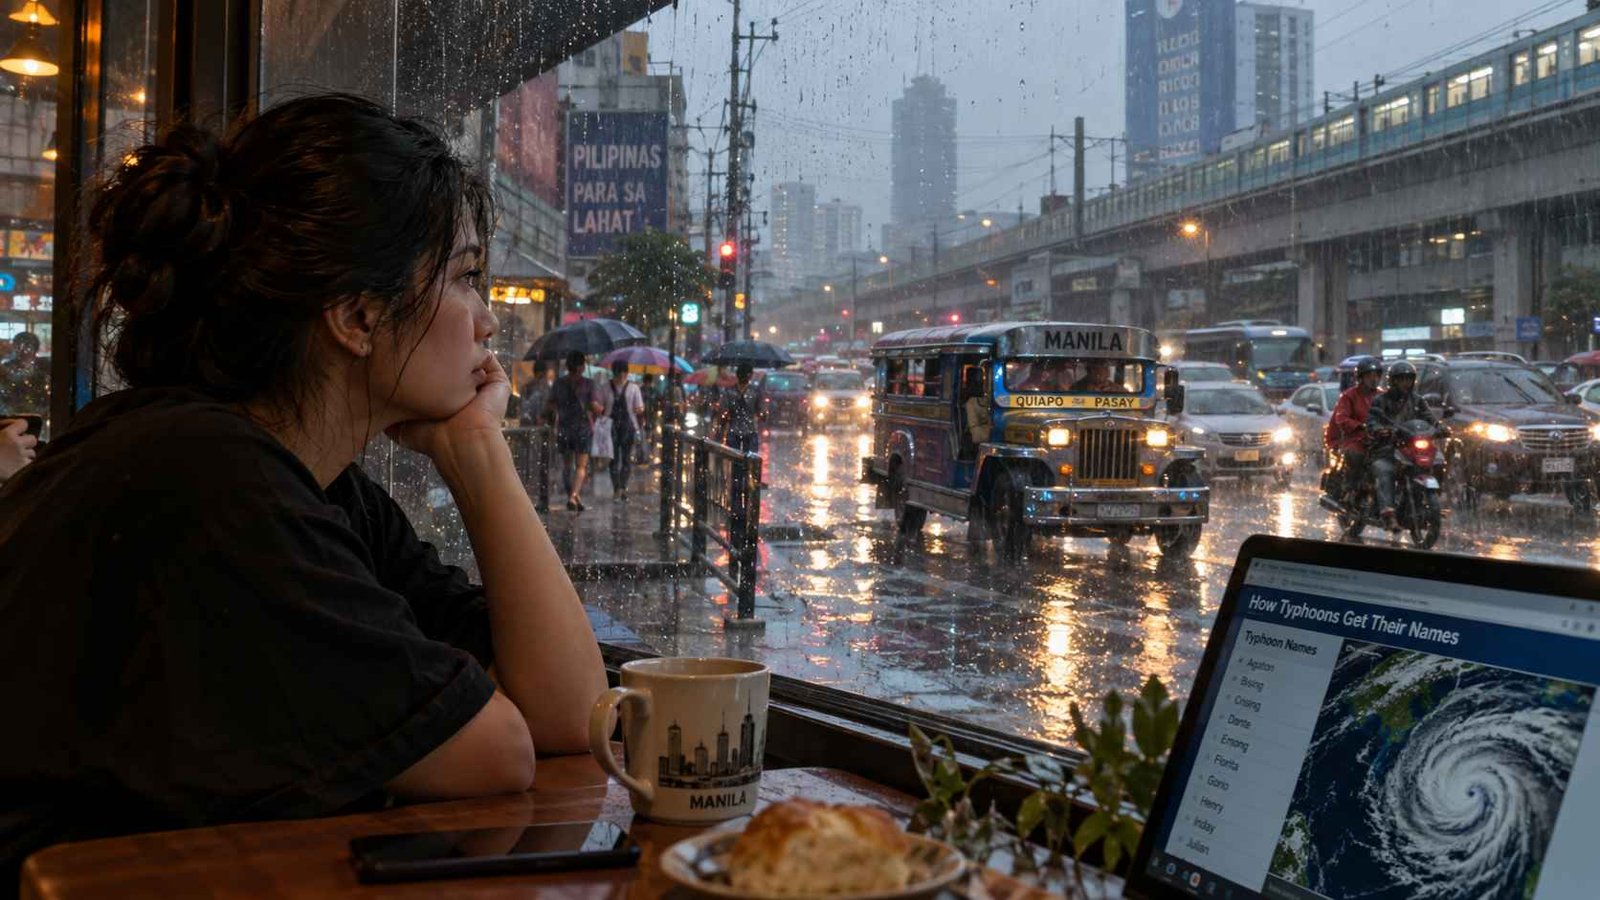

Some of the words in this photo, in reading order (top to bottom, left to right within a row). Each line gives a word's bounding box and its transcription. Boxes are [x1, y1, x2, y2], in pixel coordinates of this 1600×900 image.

[574, 145, 661, 168] PILIPINAS
[574, 182, 618, 203] PARA
[624, 181, 646, 203] SA
[574, 210, 634, 232] LAHAT
[1044, 331, 1123, 351] MANILA
[1016, 396, 1064, 407] QUIAPO
[1095, 397, 1135, 408] PASAY
[1248, 594, 1278, 612] How
[1279, 599, 1340, 625] Typhoons
[1342, 610, 1368, 629] Get
[1371, 614, 1408, 636] Their
[1408, 620, 1460, 645] Names
[1244, 630, 1283, 650] Typhoon
[1285, 639, 1318, 656] Names
[1241, 677, 1263, 692] Bising
[1228, 715, 1251, 729] Dante
[1221, 735, 1248, 752] Emong
[691, 792, 745, 808] MANILA
[1201, 797, 1223, 813] Henry
[1195, 818, 1216, 834] Inday
[1187, 839, 1209, 855] Julian
